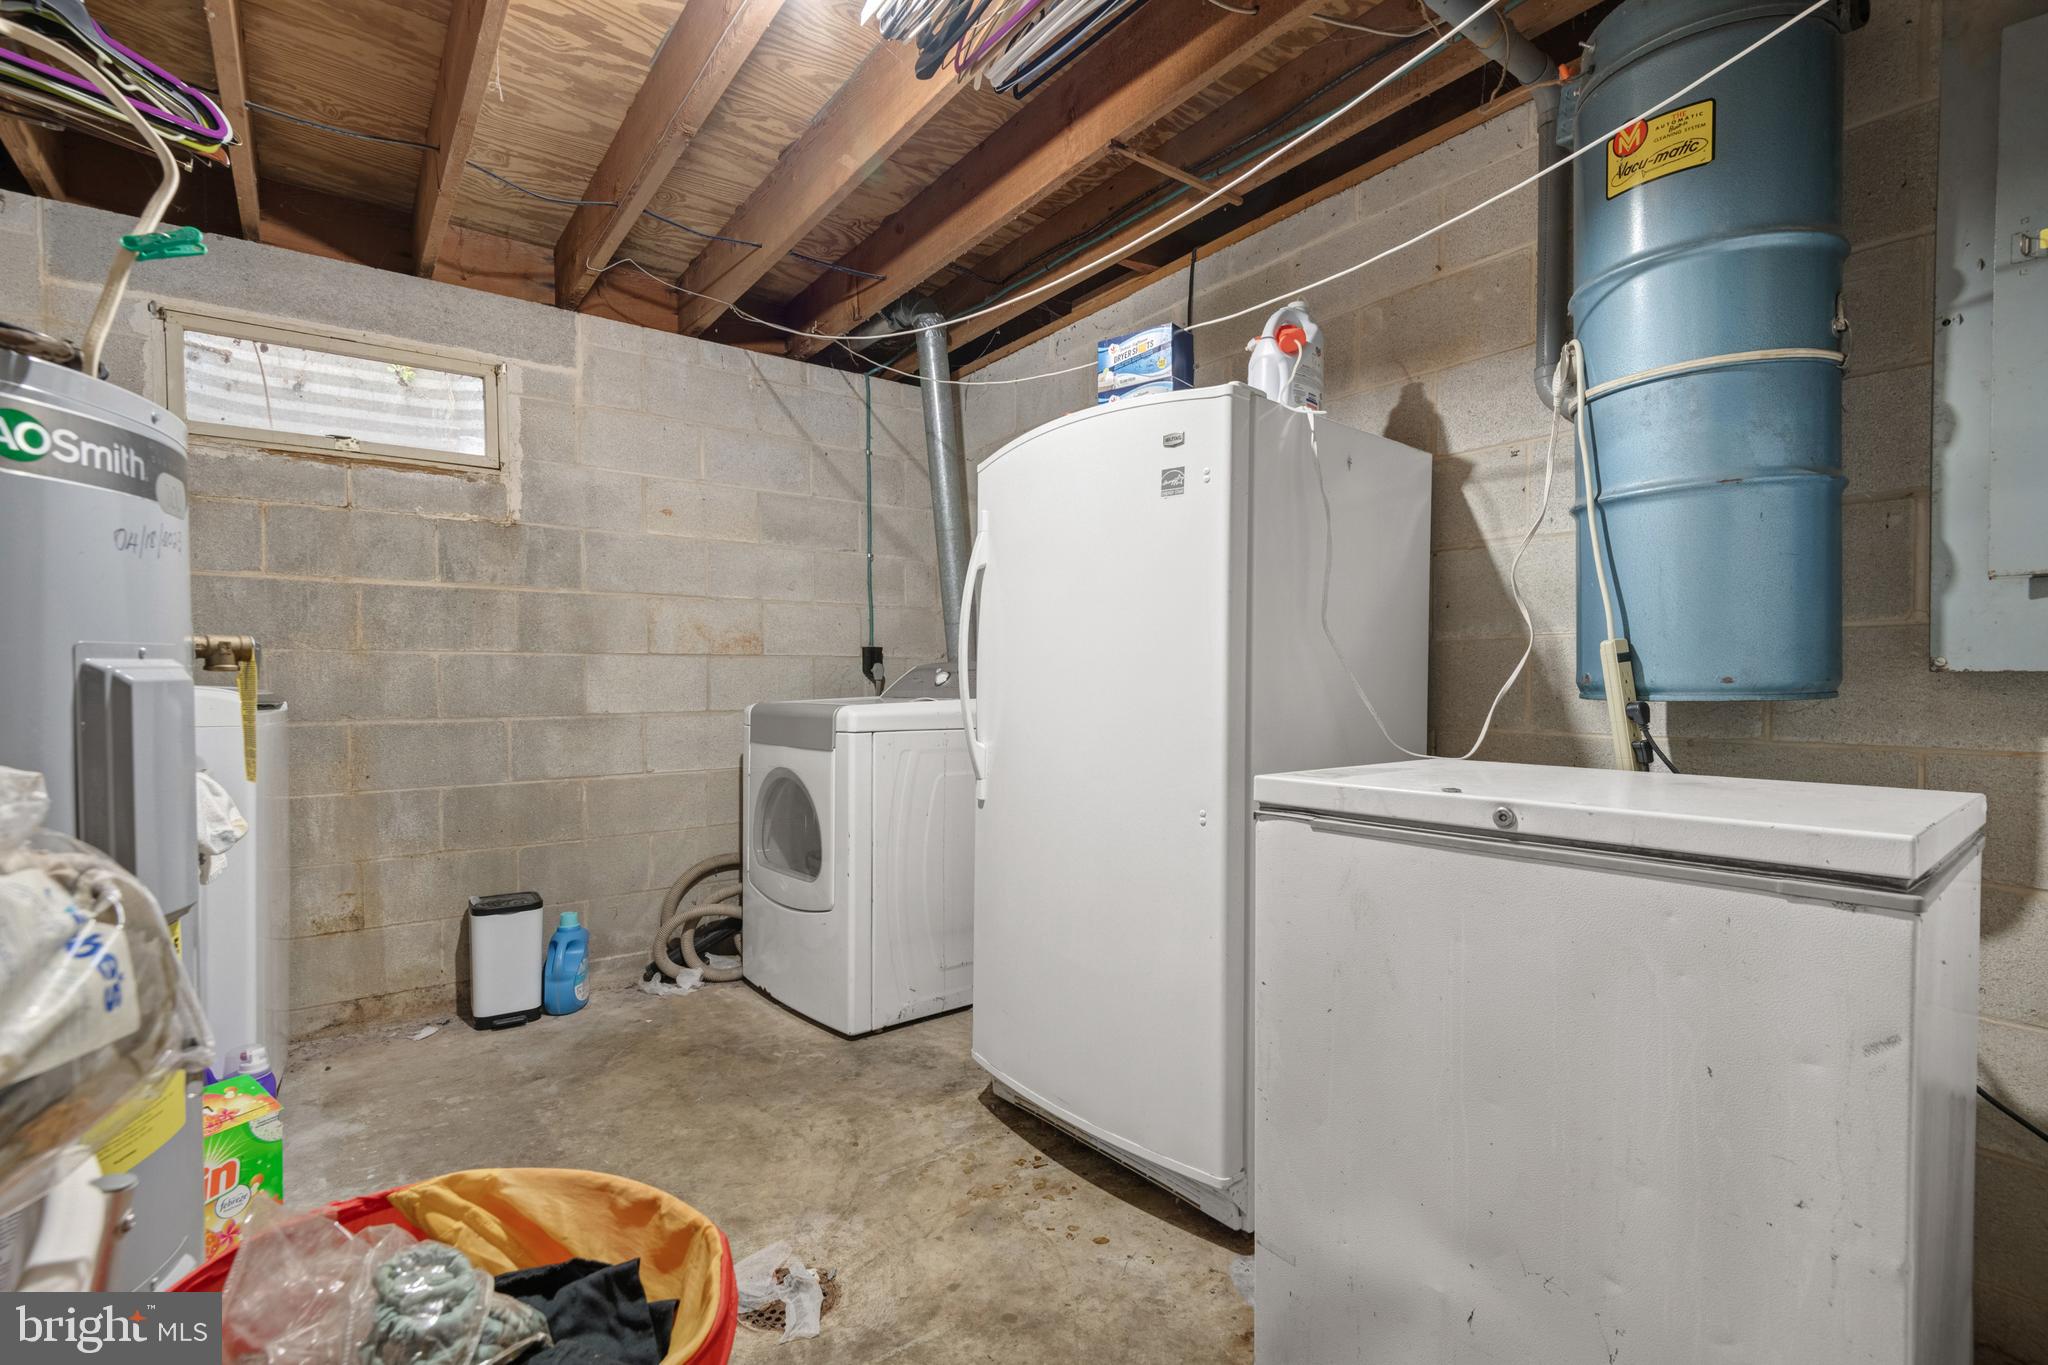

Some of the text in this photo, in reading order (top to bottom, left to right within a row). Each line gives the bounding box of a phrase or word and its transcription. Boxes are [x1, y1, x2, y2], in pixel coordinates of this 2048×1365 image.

[1655, 112, 1704, 132] AUTOMATIC
[1653, 123, 1707, 143] CLEANING SYSTEM
[1618, 140, 1700, 179] Vacu-matic
[1113, 349, 1132, 364] DRYER
[1132, 340, 1154, 354] STS
[220, 1194, 248, 1212] febreze
